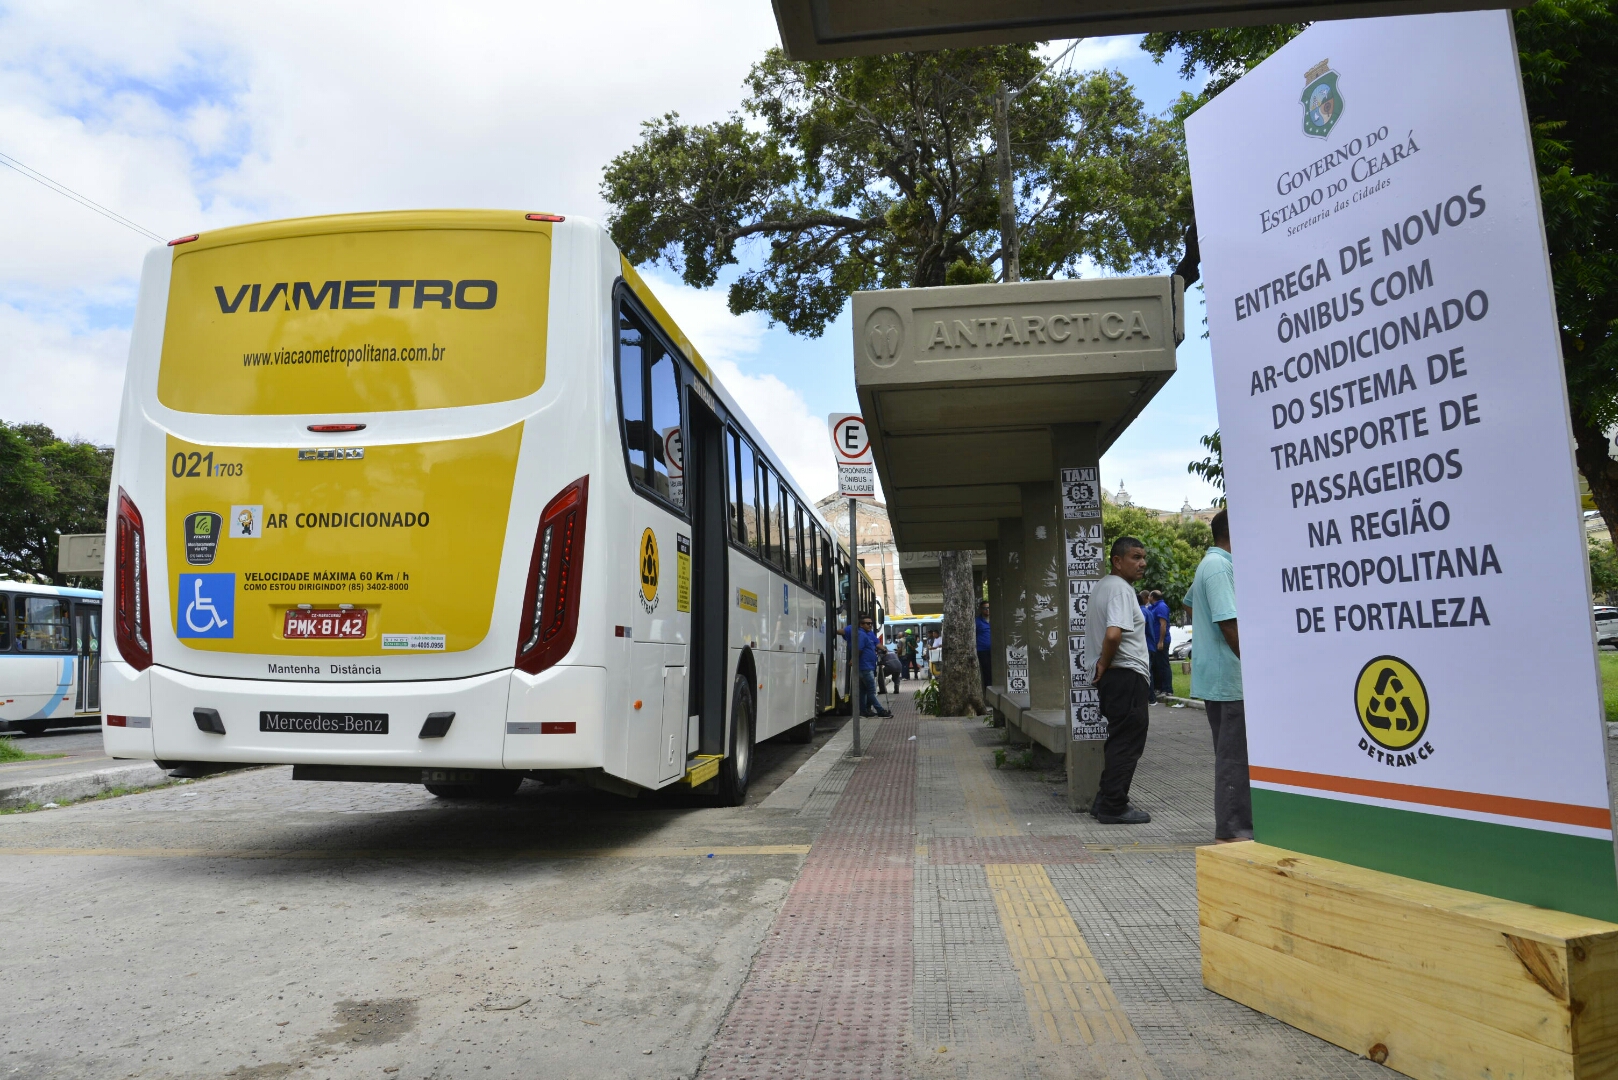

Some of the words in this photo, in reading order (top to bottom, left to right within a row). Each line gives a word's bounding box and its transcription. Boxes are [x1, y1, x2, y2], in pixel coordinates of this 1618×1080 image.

[1277, 138, 1362, 196] GOVERNO
[1366, 125, 1389, 148] DO
[1259, 188, 1323, 234] ESTADO
[1327, 178, 1348, 198] DO
[1351, 129, 1420, 182] CEARÁ
[1287, 210, 1330, 237] Secretaria
[1334, 197, 1350, 214] das
[1352, 177, 1391, 203] Cidades
[1234, 258, 1331, 321] ENTREGA
[1339, 236, 1373, 275] DE
[1382, 184, 1486, 256] NOVOS
[214, 280, 498, 314] VIAMETRO
[1277, 287, 1364, 344] ÔNIBUS
[1370, 258, 1434, 306] COM
[928, 311, 1151, 350] ANTARCTICA
[1250, 289, 1489, 396] AR-CONDICIONADO
[243, 343, 446, 367] www.viacaometropolitana.com.br
[1272, 398, 1305, 430] DO
[1310, 363, 1417, 419] SISTEMA
[1427, 346, 1468, 385] DE
[845, 425, 860, 449] E
[1270, 406, 1429, 471] TRANSPORTE
[1439, 393, 1481, 432] DE
[297, 447, 365, 461] CAIO
[1064, 469, 1094, 482] TAXI
[1290, 448, 1463, 509] PASSAGEIROS
[1071, 485, 1089, 499] 65
[266, 514, 288, 528] AR
[295, 511, 430, 528] CONDICIONADO
[1308, 519, 1342, 548] NA
[1350, 497, 1450, 543] REGIÃO
[1075, 543, 1092, 557] 65
[244, 572, 310, 581] VELOCIDADE
[313, 570, 356, 581] MÁXIMA
[360, 572, 373, 581] 60
[376, 572, 393, 581] Km
[403, 572, 409, 581] h
[1281, 544, 1502, 593] METROPOLITANA
[244, 583, 267, 591] COMO
[269, 583, 296, 591] ESTOU
[298, 583, 346, 591] DIRIGINDO?
[348, 583, 364, 592] (85)
[366, 583, 409, 591] 3402-8000
[1072, 580, 1097, 594] TAX
[1296, 607, 1326, 634] DE
[1334, 596, 1491, 632] FORTALEZA
[268, 663, 320, 674] Mantenha
[330, 663, 381, 674] Distância
[1009, 669, 1028, 677] TAXI
[1012, 679, 1023, 688] 65
[1072, 690, 1099, 703] TAX
[265, 713, 383, 732] Mercedes-Benz
[1081, 707, 1098, 721] 65
